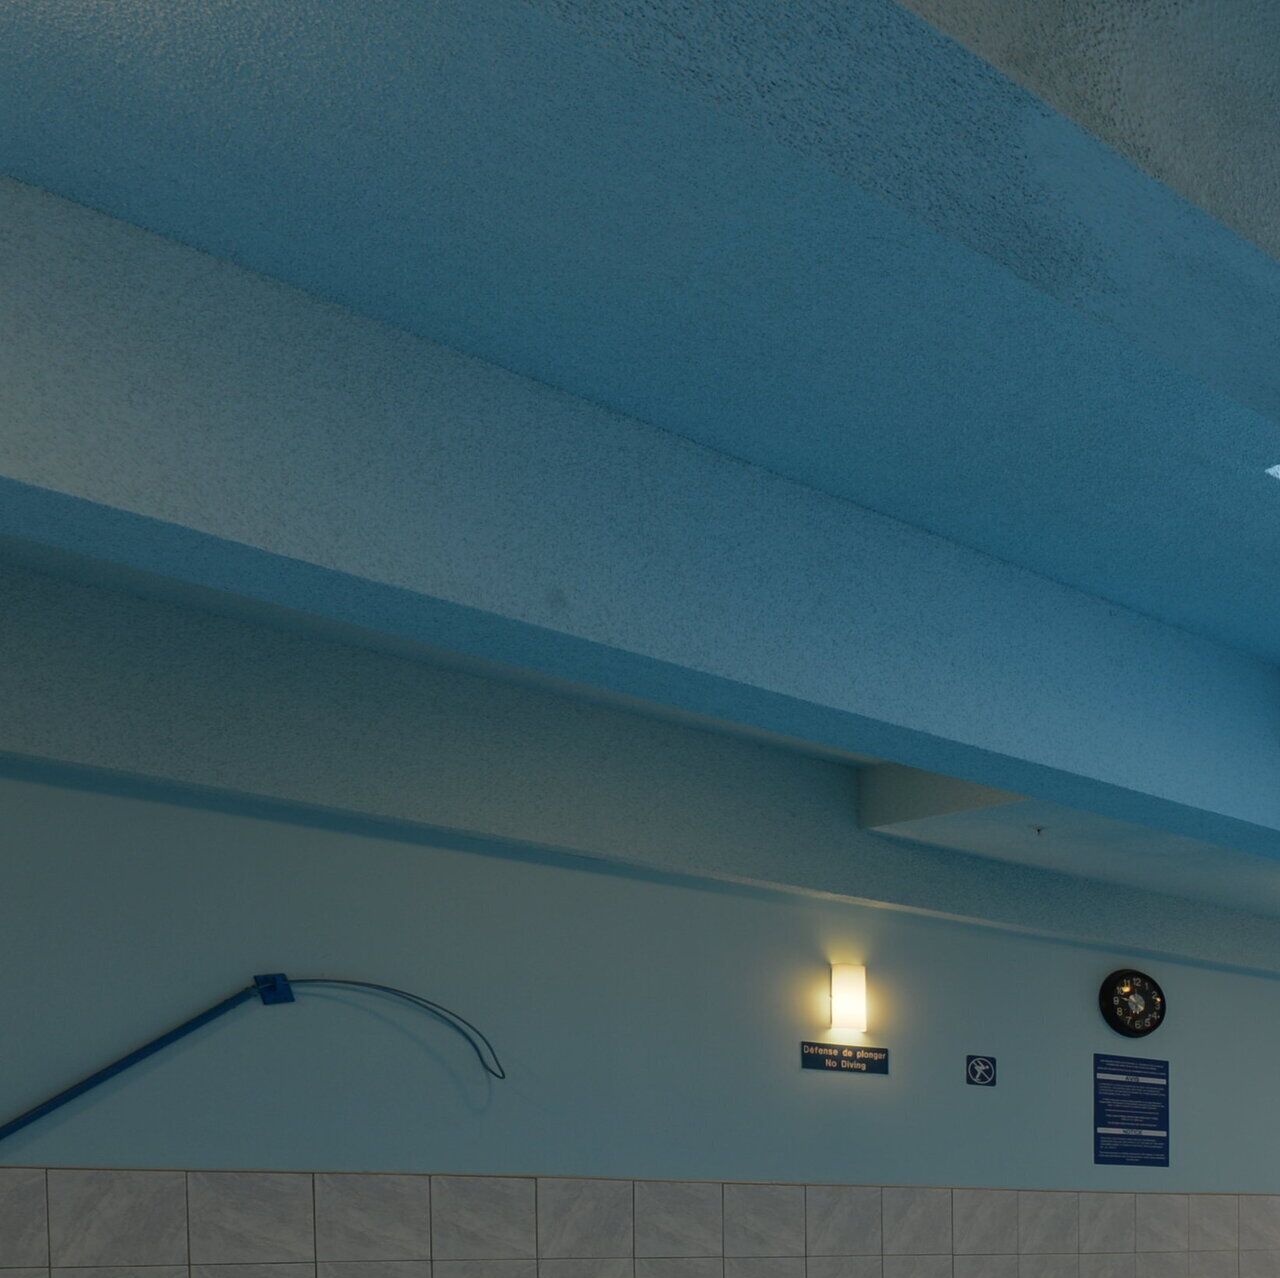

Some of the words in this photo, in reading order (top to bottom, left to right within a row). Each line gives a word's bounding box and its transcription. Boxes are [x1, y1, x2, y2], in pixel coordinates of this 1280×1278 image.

[1132, 977, 1142, 987] 12
[1112, 995, 1120, 1006] 9
[1116, 1006, 1124, 1017] 8
[1134, 1019, 1142, 1030] 6
[1144, 1017, 1151, 1028] 5
[803, 1045, 838, 1056] Défense
[825, 1059, 837, 1067] No
[841, 1060, 867, 1070] Diving
